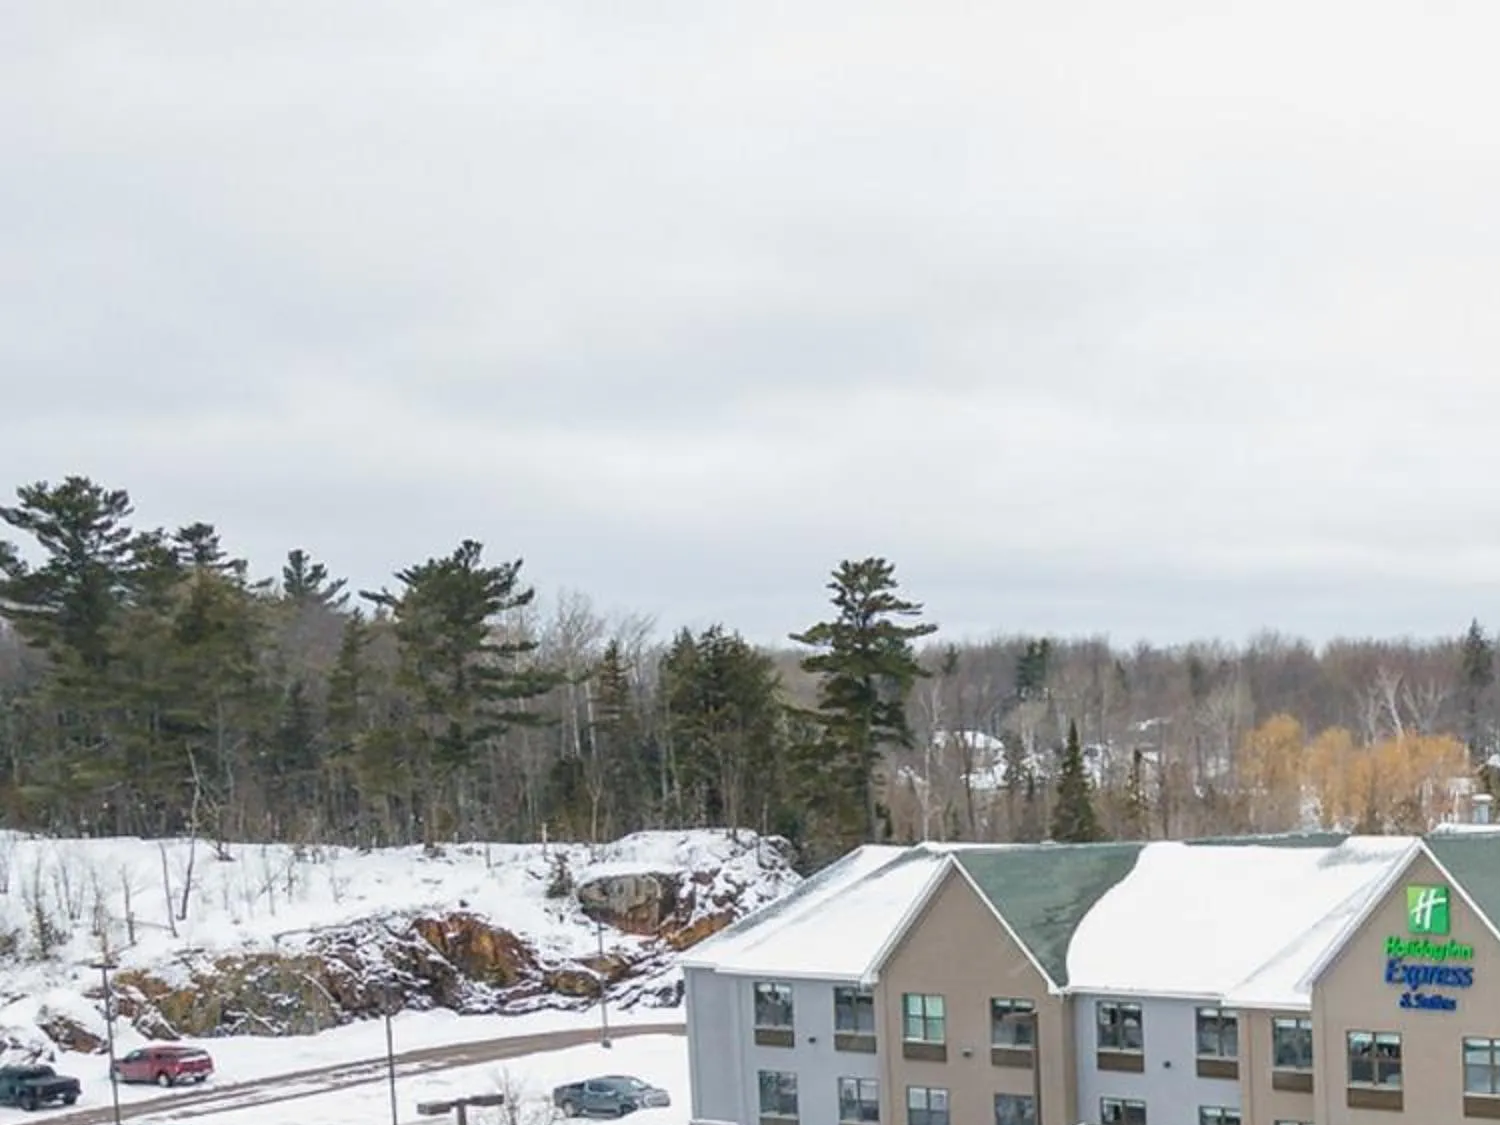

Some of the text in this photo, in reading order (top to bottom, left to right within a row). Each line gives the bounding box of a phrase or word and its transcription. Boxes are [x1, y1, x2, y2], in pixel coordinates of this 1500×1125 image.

[1386, 936, 1474, 961] Holiday Inn
[1385, 956, 1474, 990] Express
